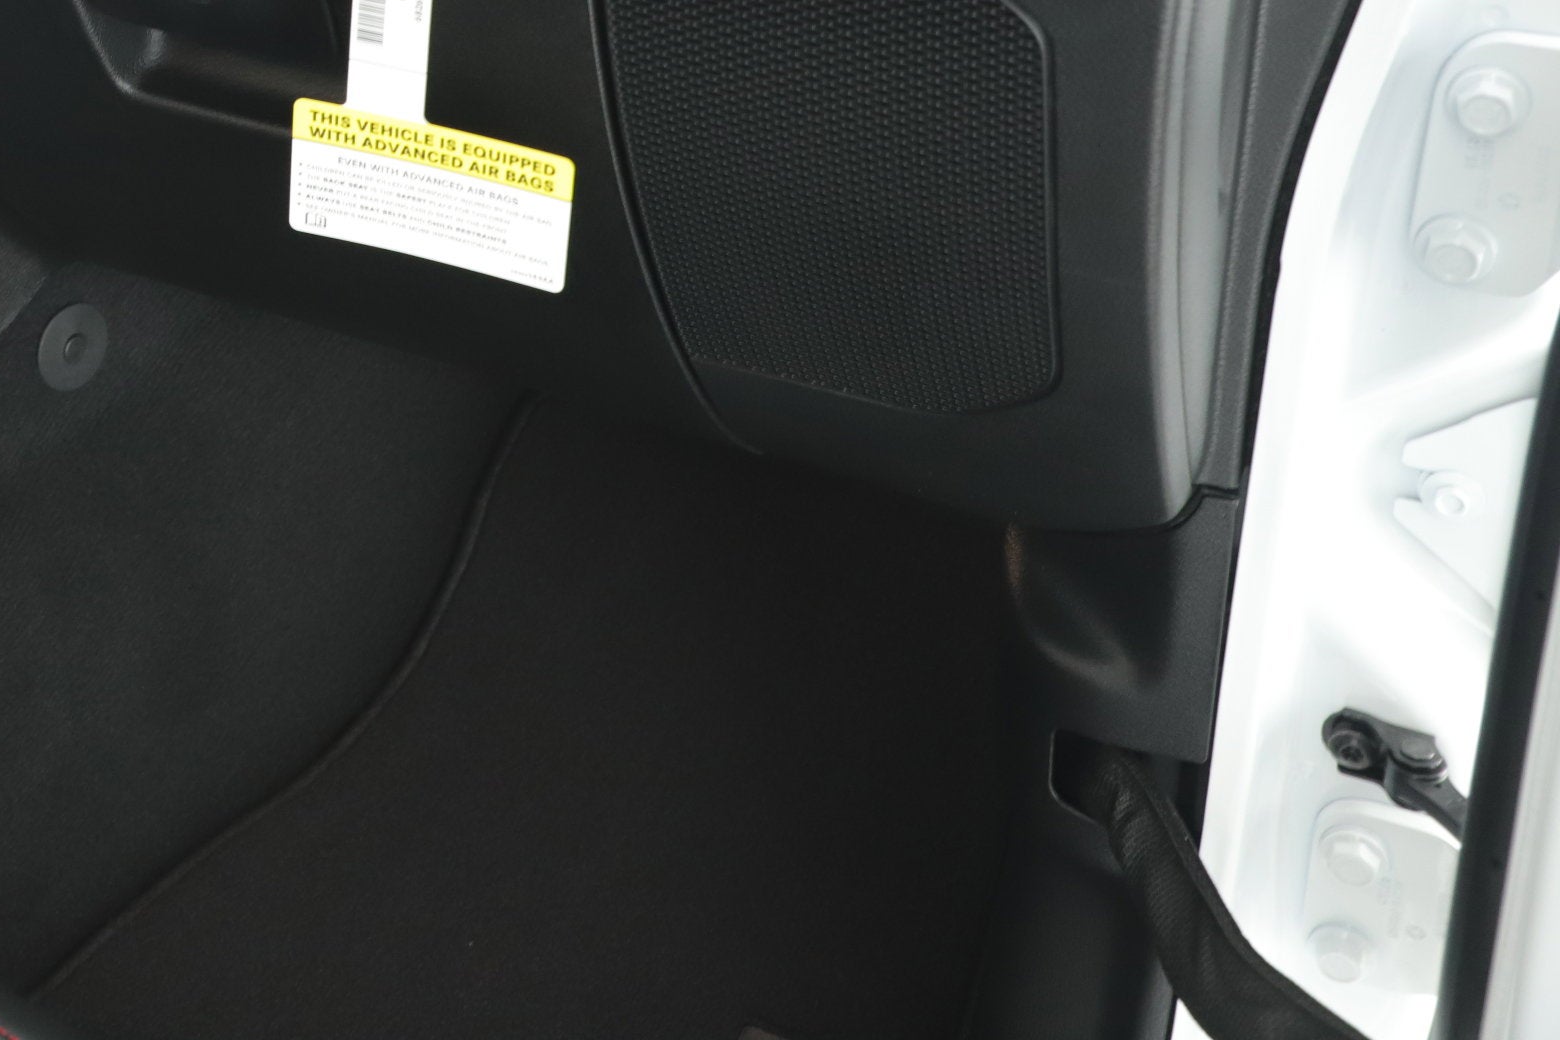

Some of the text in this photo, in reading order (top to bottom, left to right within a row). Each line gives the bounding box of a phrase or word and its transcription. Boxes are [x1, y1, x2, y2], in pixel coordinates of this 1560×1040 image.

[309, 109, 557, 177] THIS VEHICLE IS EQUIPPED
[309, 125, 556, 193] WITH ADVANCED AIR BAGS
[337, 156, 520, 206] EVEN WITH ADVANCED AIR BAGS
